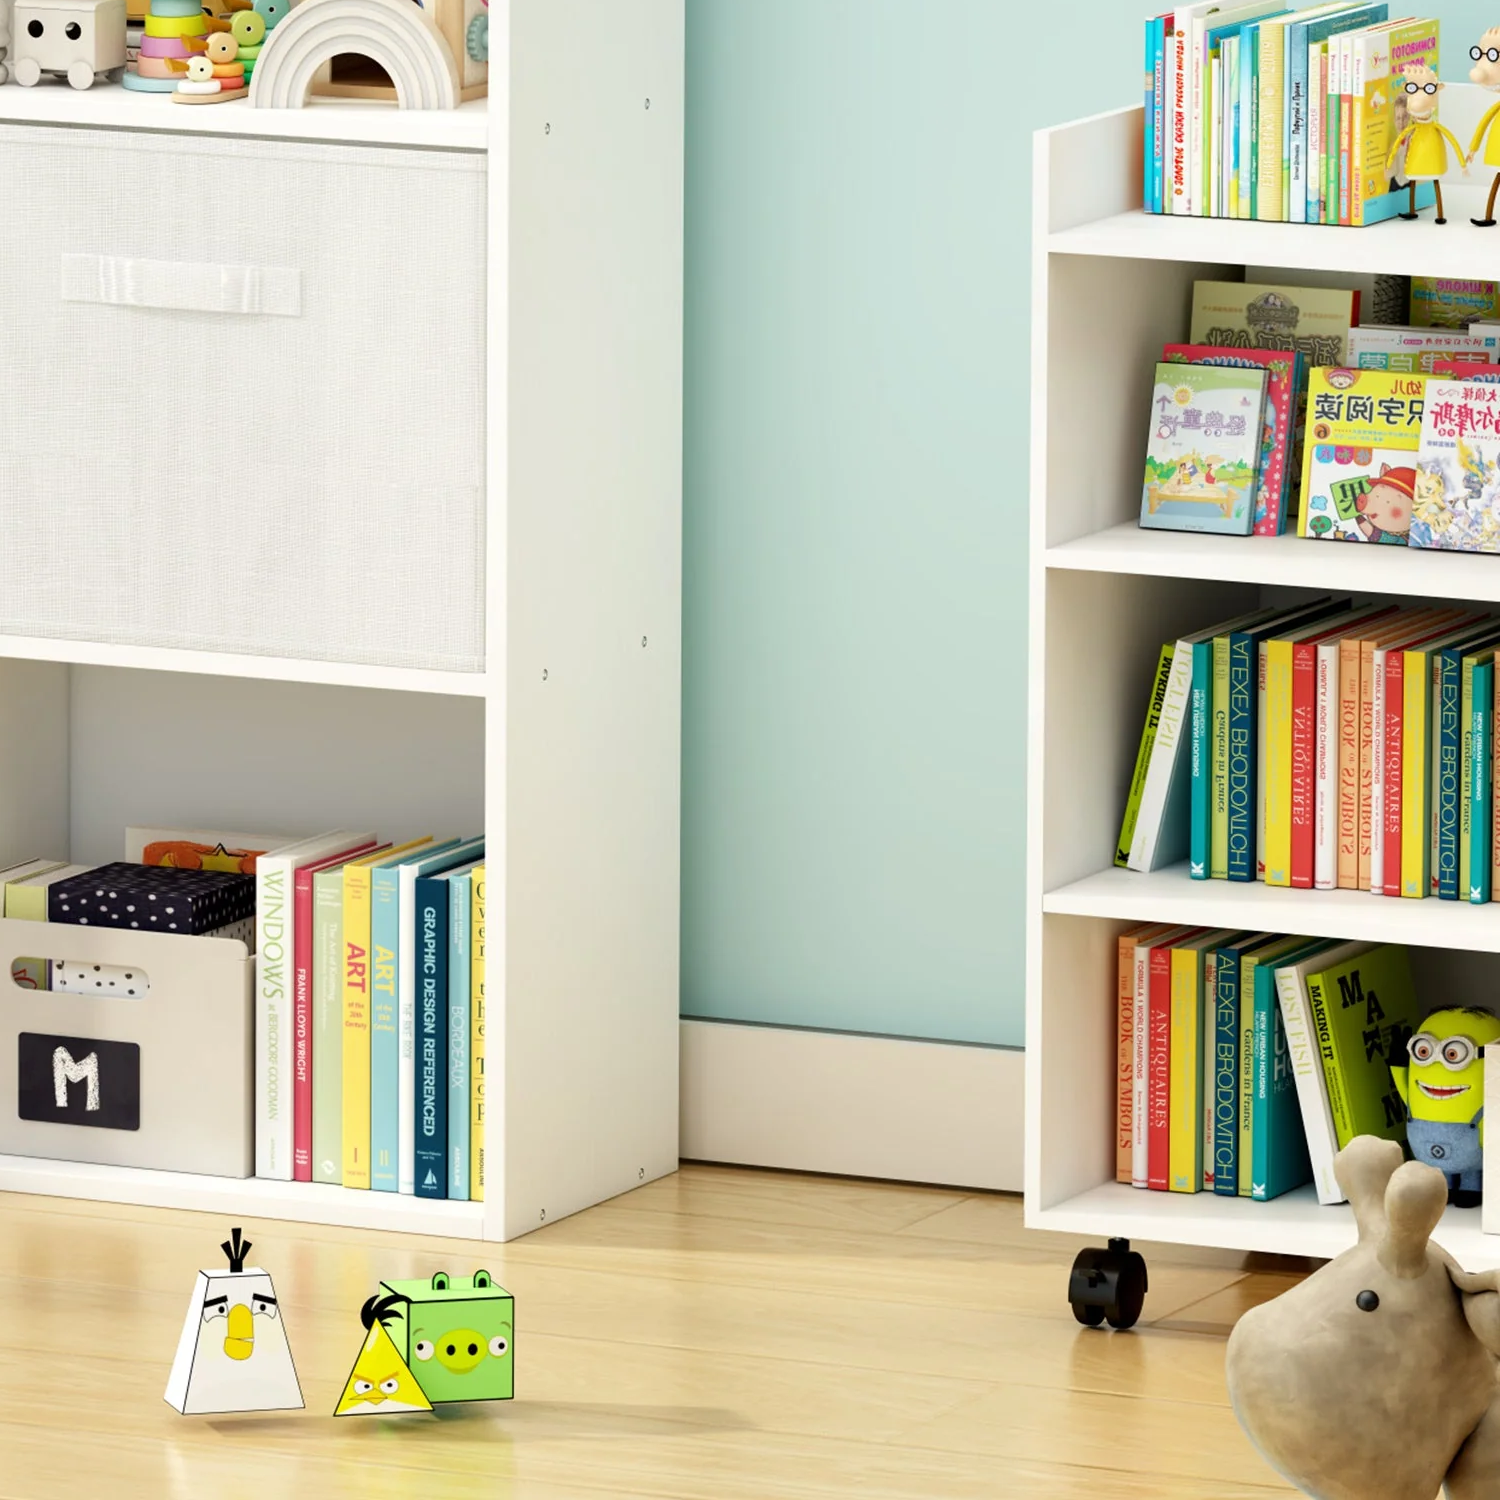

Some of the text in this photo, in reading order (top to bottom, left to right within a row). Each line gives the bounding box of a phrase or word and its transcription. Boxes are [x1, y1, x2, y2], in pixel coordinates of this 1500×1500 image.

[1175, 40, 1184, 186] ЗОЛОТЫЕ СКАЗКИ РУССКОГО НАРОДА
[1373, 663, 1382, 700] FORMULA
[1361, 700, 1373, 749] BOOK
[1373, 708, 1381, 735] WORLD
[1373, 736, 1381, 785] CHAMPIONS
[1388, 713, 1400, 834] ANTIQUAIRES
[1440, 656, 1458, 884] ALEXEY BRODOVITCH
[1463, 730, 1472, 777] Gardens
[1475, 711, 1483, 801] NEW URBAN HOUSING
[1360, 768, 1372, 856] SYMBOLS
[1463, 795, 1472, 834] France
[262, 869, 285, 1001] WINDOWS
[423, 906, 437, 974] GRAPHIC
[347, 941, 366, 994] ART
[375, 944, 395, 996] ART
[1136, 960, 1145, 997] FORMULA
[296, 967, 307, 1083] FRANK LLOYD WRIGHT
[423, 978, 437, 1034] DESIGN
[1120, 996, 1134, 1045] BOOK
[1136, 1005, 1145, 1033] WORLD
[1278, 974, 1306, 1034] LOST
[1310, 984, 1334, 1060] MAKING IT
[268, 1013, 279, 1064] BERGDORF
[451, 1005, 465, 1089] BORDEAUX
[1136, 1034, 1145, 1080] CHAMPIONS
[1243, 1028, 1253, 1075] Gardens
[51, 1044, 100, 1113] M
[268, 1066, 278, 1120] GOODMAN
[423, 1037, 437, 1137] REFERENCED
[1155, 1009, 1167, 1129] ANTIQUAIRES
[1216, 954, 1236, 1180] ALEXEY BRODOVITCH
[1119, 1062, 1133, 1150] SYMBOLS
[1243, 1092, 1253, 1131] France
